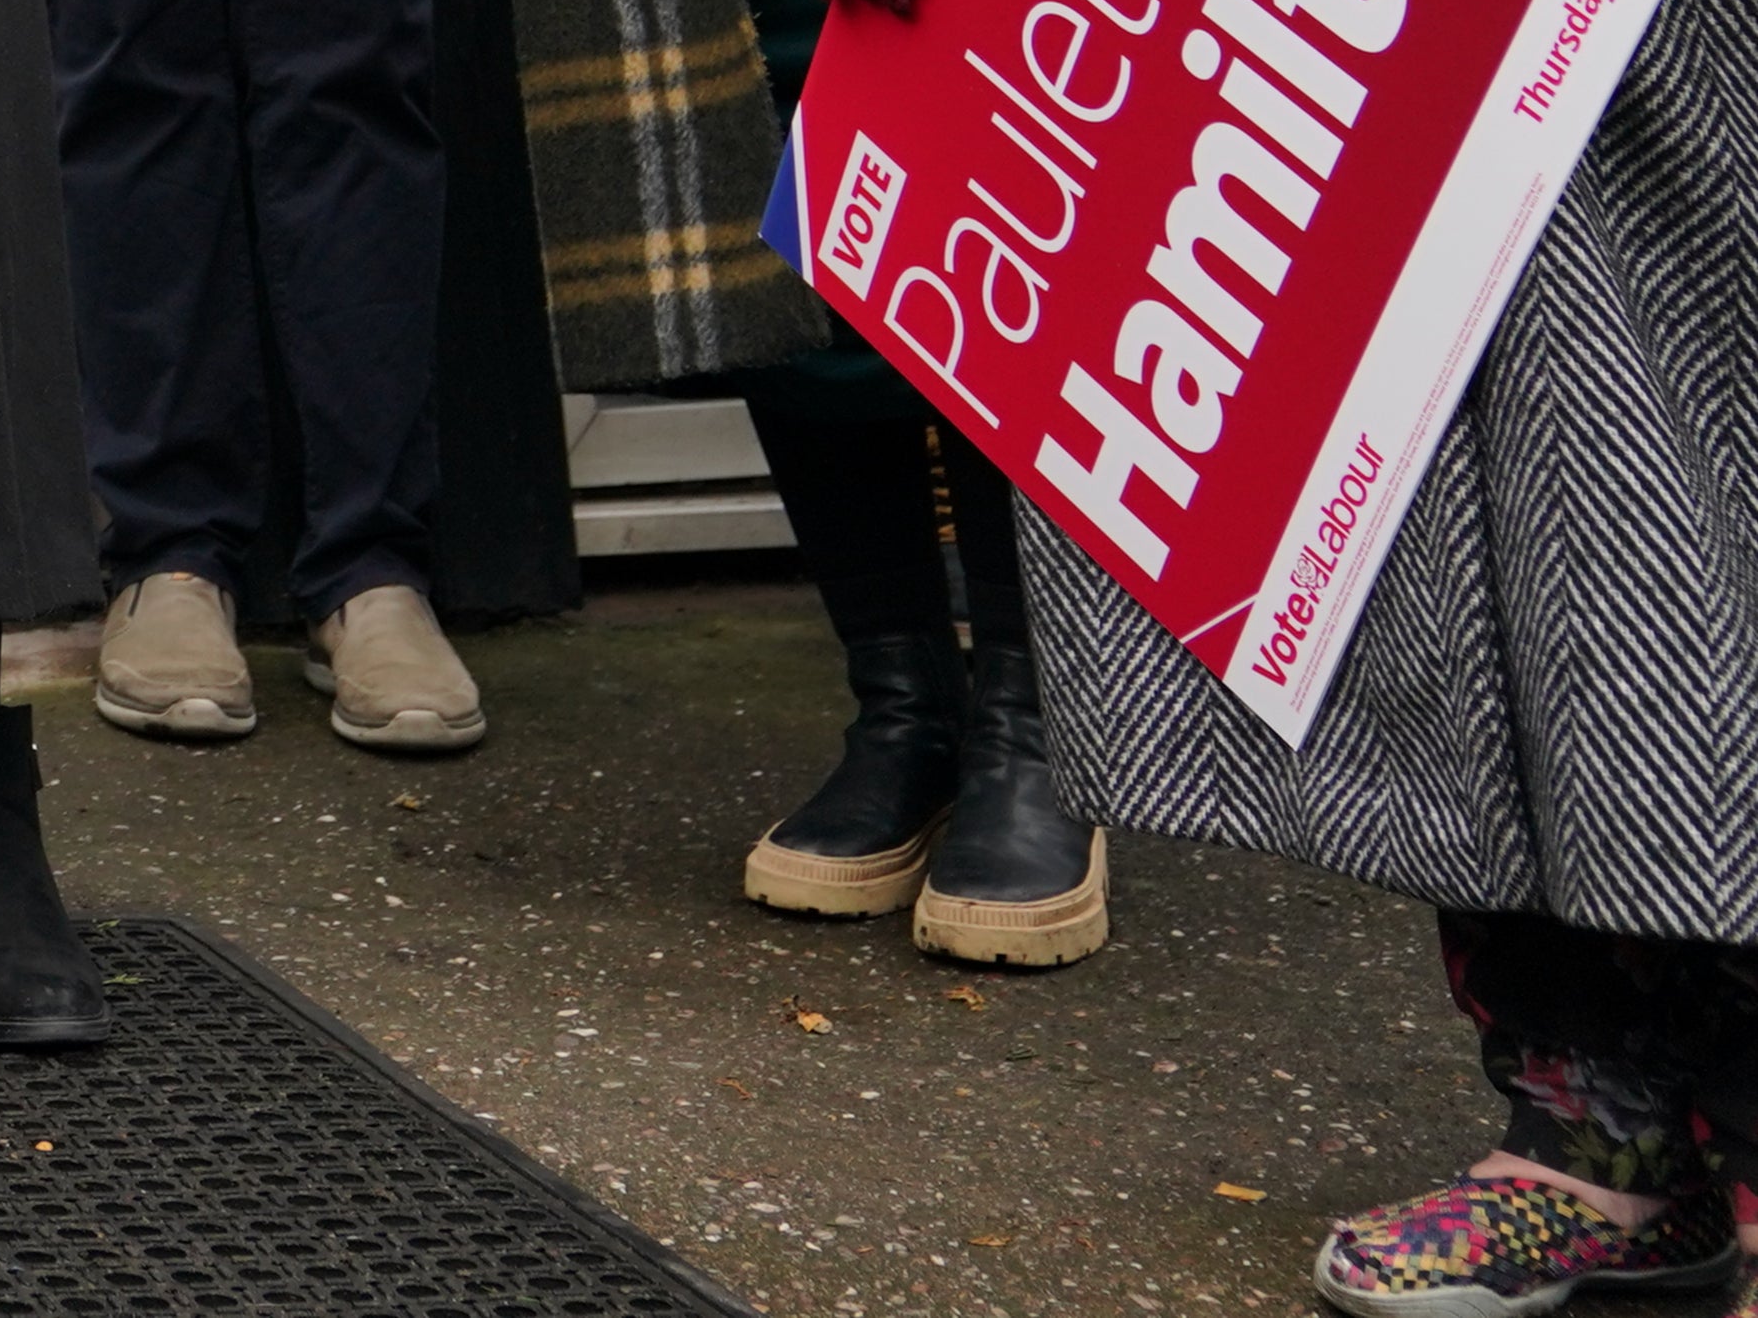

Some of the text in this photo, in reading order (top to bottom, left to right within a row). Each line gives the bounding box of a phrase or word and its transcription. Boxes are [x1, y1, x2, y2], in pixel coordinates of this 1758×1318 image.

[831, 152, 892, 271] VOTE
[1252, 432, 1385, 687] Vote Labour
